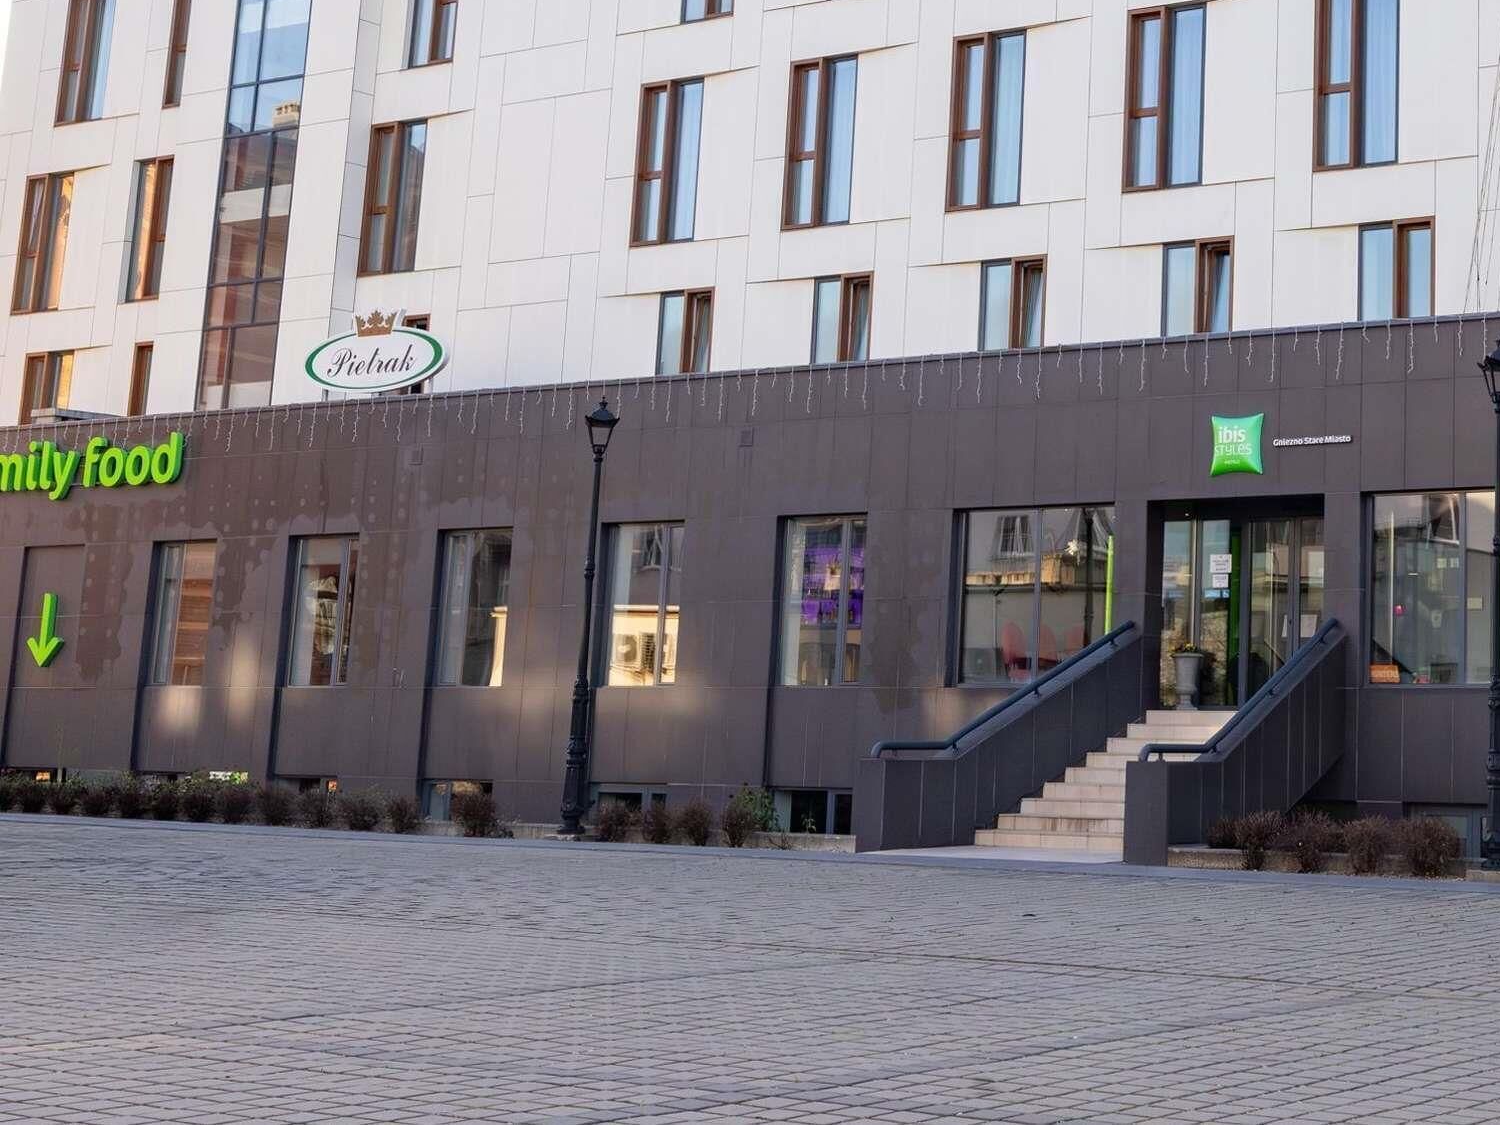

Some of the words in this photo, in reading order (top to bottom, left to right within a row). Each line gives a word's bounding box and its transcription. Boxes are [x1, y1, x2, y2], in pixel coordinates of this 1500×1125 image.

[327, 344, 415, 378] Pietrak
[1218, 425, 1247, 443] ibis
[82, 431, 185, 489] food
